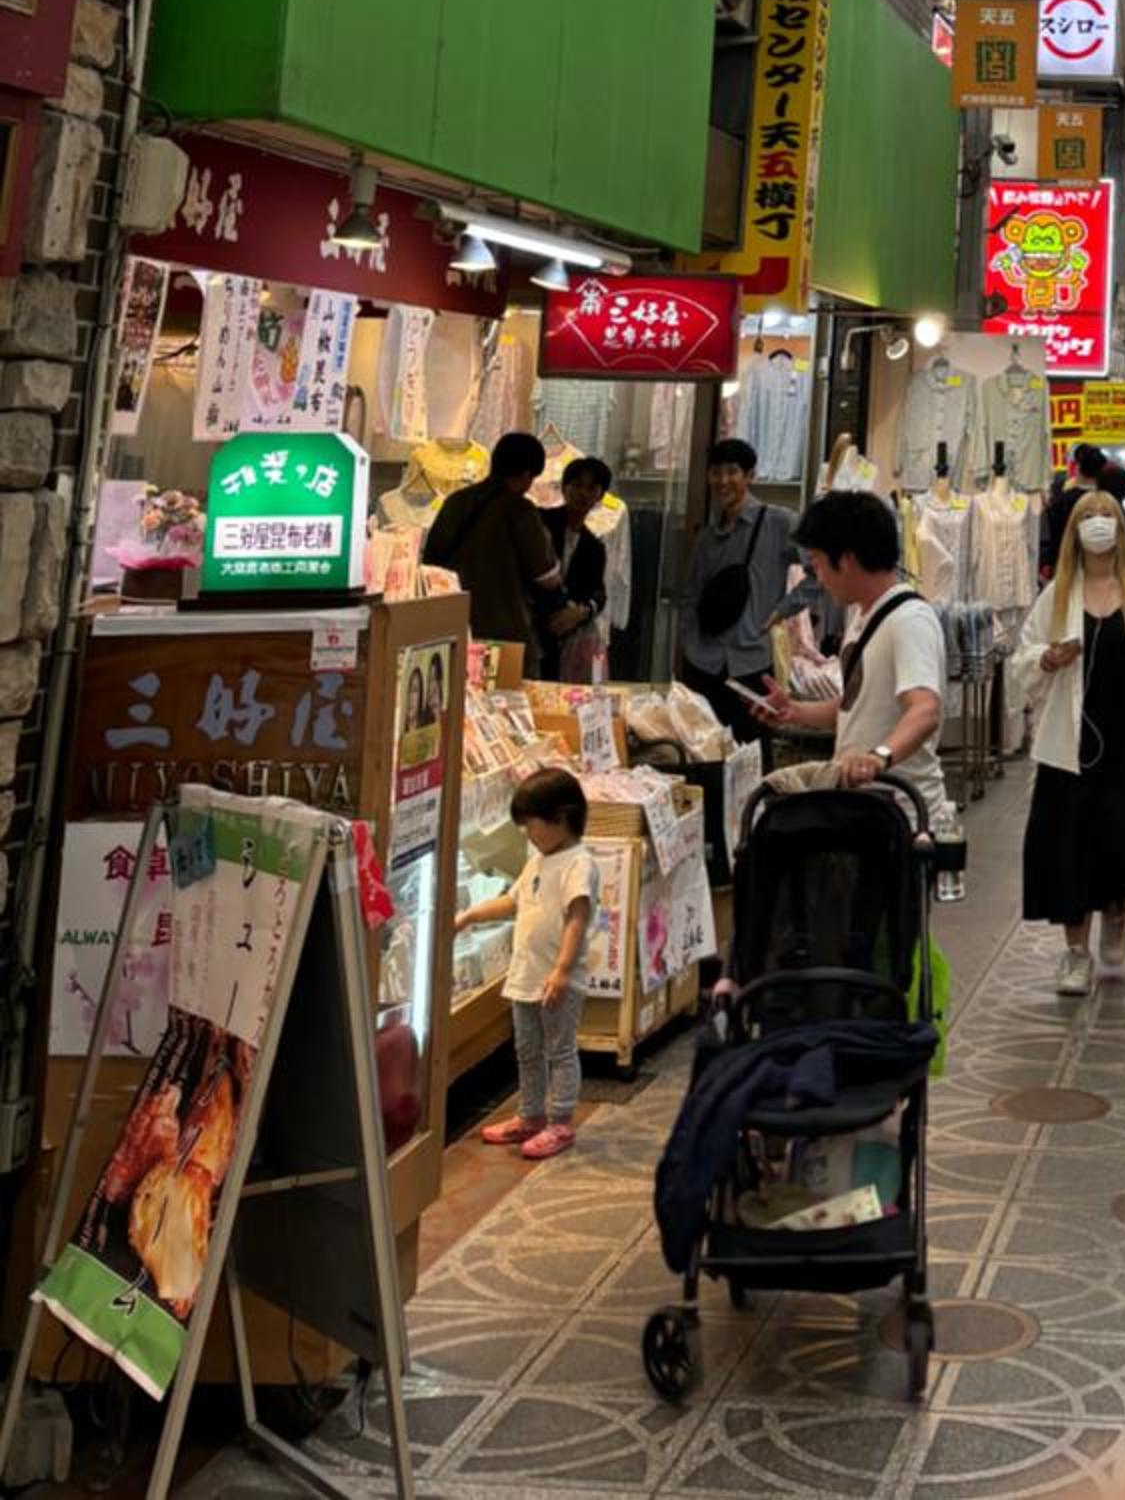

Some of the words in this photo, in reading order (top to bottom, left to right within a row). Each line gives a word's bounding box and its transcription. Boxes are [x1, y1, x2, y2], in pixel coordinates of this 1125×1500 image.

[1040, 16, 1110, 35] スシロー
[61, 929, 119, 946] ALWAY
